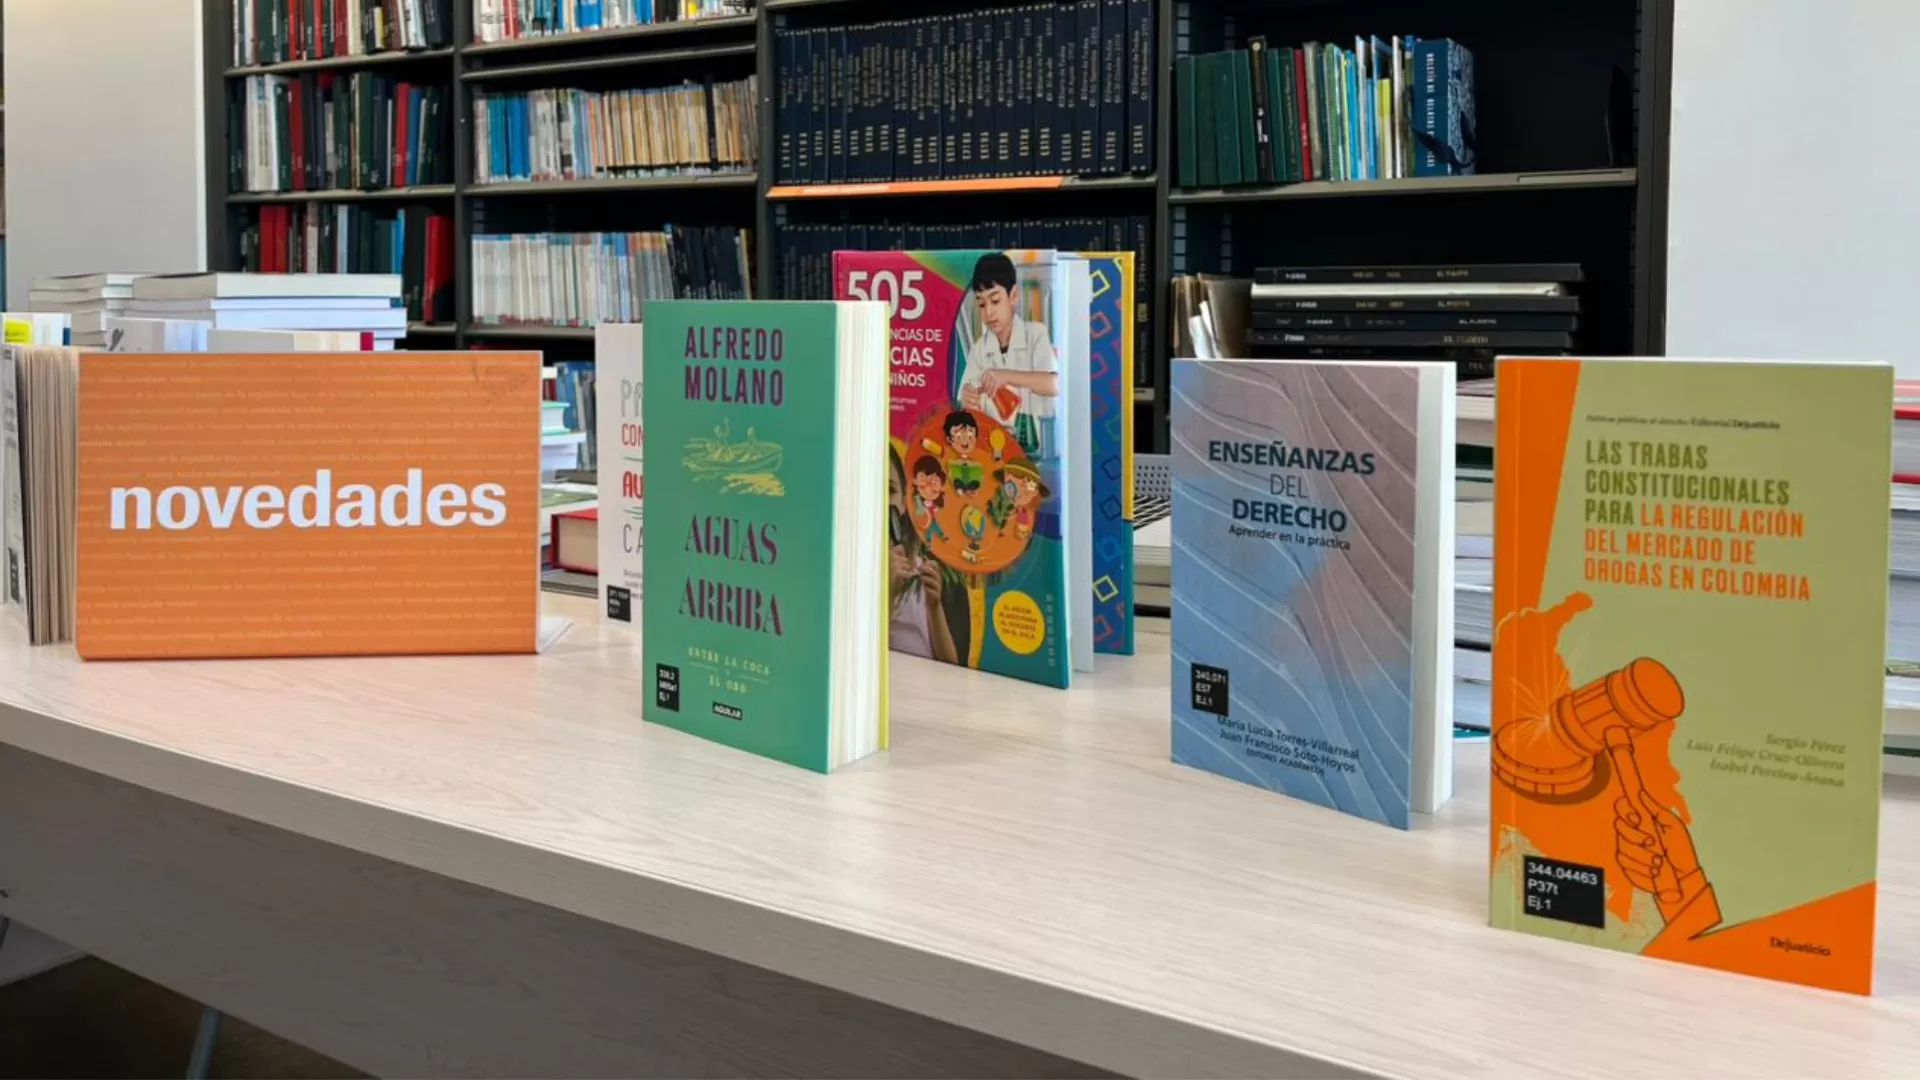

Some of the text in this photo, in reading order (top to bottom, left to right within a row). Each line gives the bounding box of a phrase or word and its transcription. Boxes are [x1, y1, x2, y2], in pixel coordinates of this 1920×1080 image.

[848, 270, 925, 320] 505
[685, 326, 783, 361] ALFREDO
[925, 329, 943, 342] DE
[890, 346, 934, 367] CIAS
[685, 365, 784, 406] MOLANO
[1208, 440, 1376, 475] ENSEÑANZAS
[1586, 439, 1708, 470] LAS TRABAS
[110, 469, 507, 530] novedades
[1269, 474, 1308, 498] DEL
[1585, 469, 1790, 505] CONSTITUCIONALES
[1232, 499, 1347, 532] DERECHO
[1585, 498, 1805, 537] PARA LA REGULACIÓN
[685, 512, 778, 565] AGUAS
[1228, 524, 1351, 551] Aprender en la práctica
[1585, 528, 1755, 565] DEL MERCADO DE
[1585, 557, 1810, 601] DROGAS EN COLOMBIA
[679, 577, 782, 637] ARRIBA
[743, 659, 770, 676] COCA
[1220, 728, 1356, 773] Juan Francisco Soto-Hoyos
[1276, 729, 1360, 759] Torres-Villarreal
[1687, 738, 1715, 752] Luis
[1716, 743, 1756, 759] Felipe
[1767, 733, 1808, 750] Sergio
[1709, 758, 1748, 774] Isabel
[1528, 862, 1598, 885] 344.04463
[1528, 878, 1559, 895] P37t
[1528, 895, 1551, 910] Ej.1
[1770, 936, 1832, 957] Dejusticia
